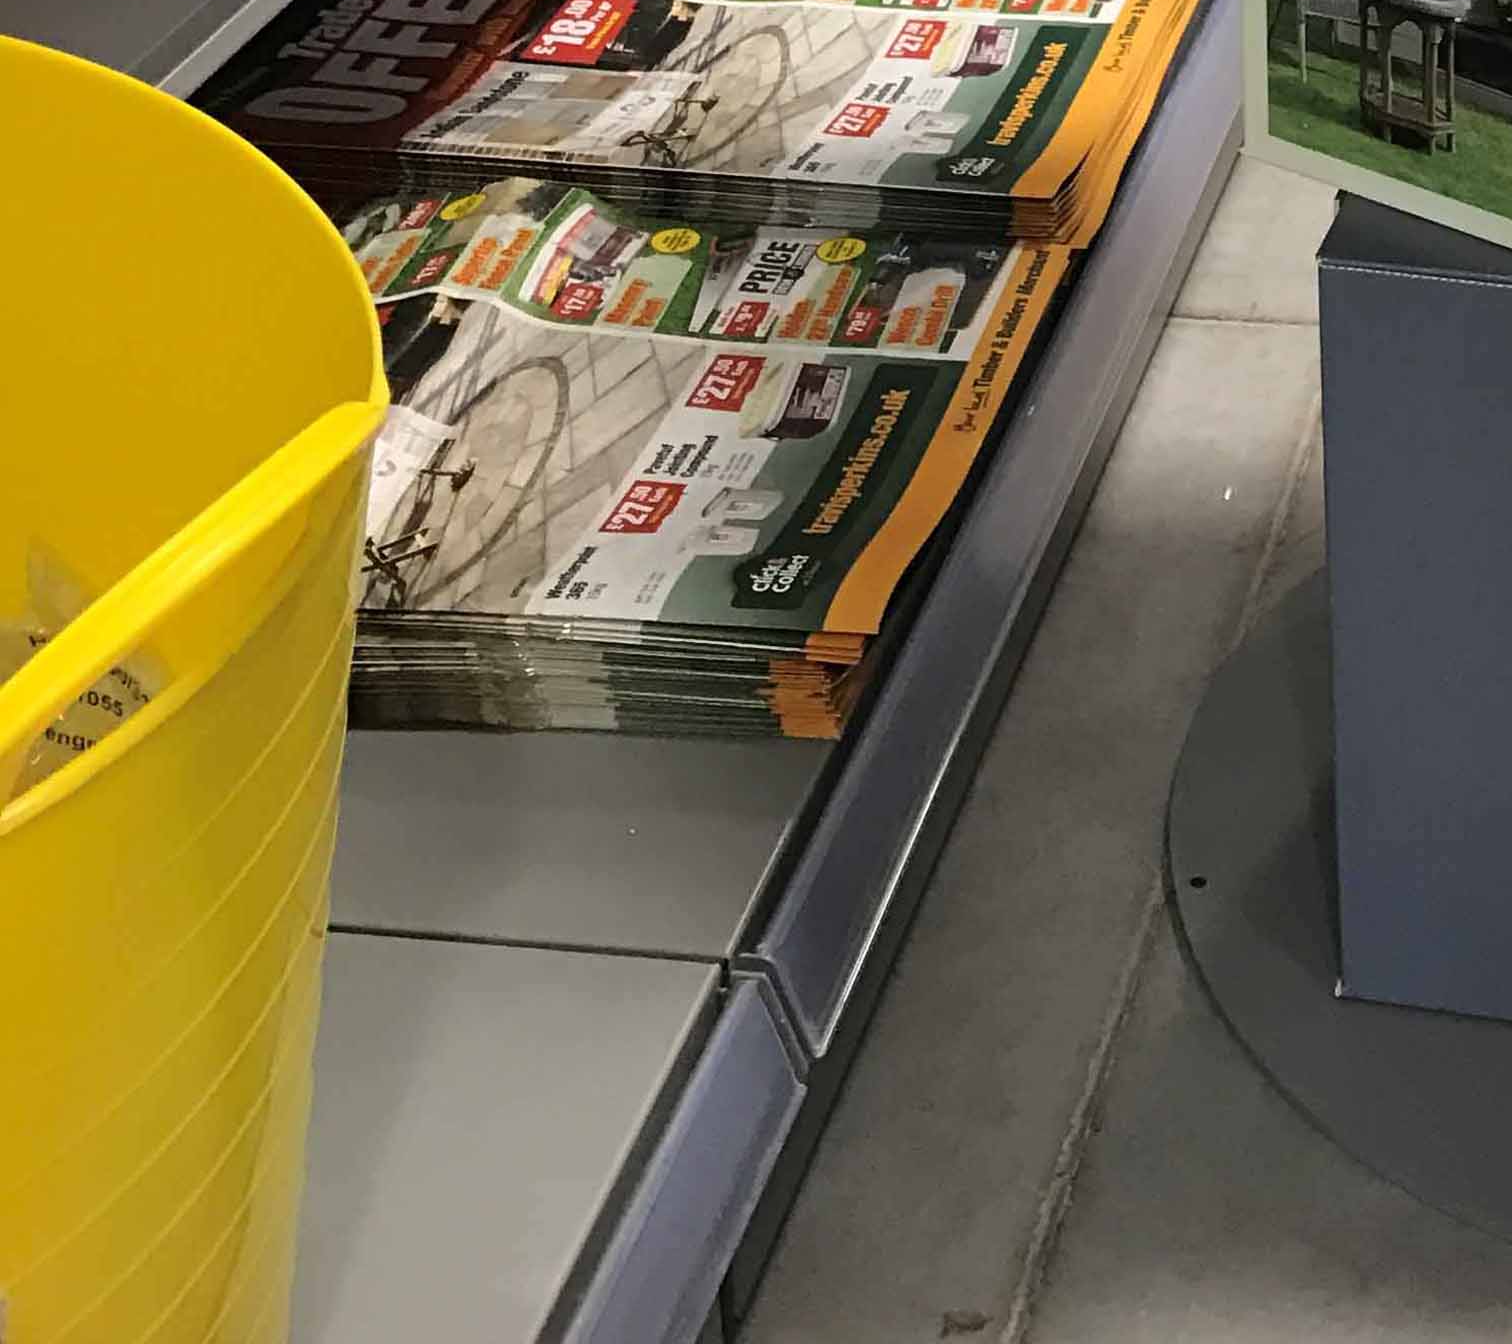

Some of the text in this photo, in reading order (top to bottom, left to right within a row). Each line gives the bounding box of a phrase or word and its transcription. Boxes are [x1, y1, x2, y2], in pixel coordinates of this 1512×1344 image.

[738, 240, 800, 295] PRICE
[972, 350, 1004, 387] Timber
[800, 388, 911, 536] travisperkins.co.uk
[771, 554, 810, 594] Collect
